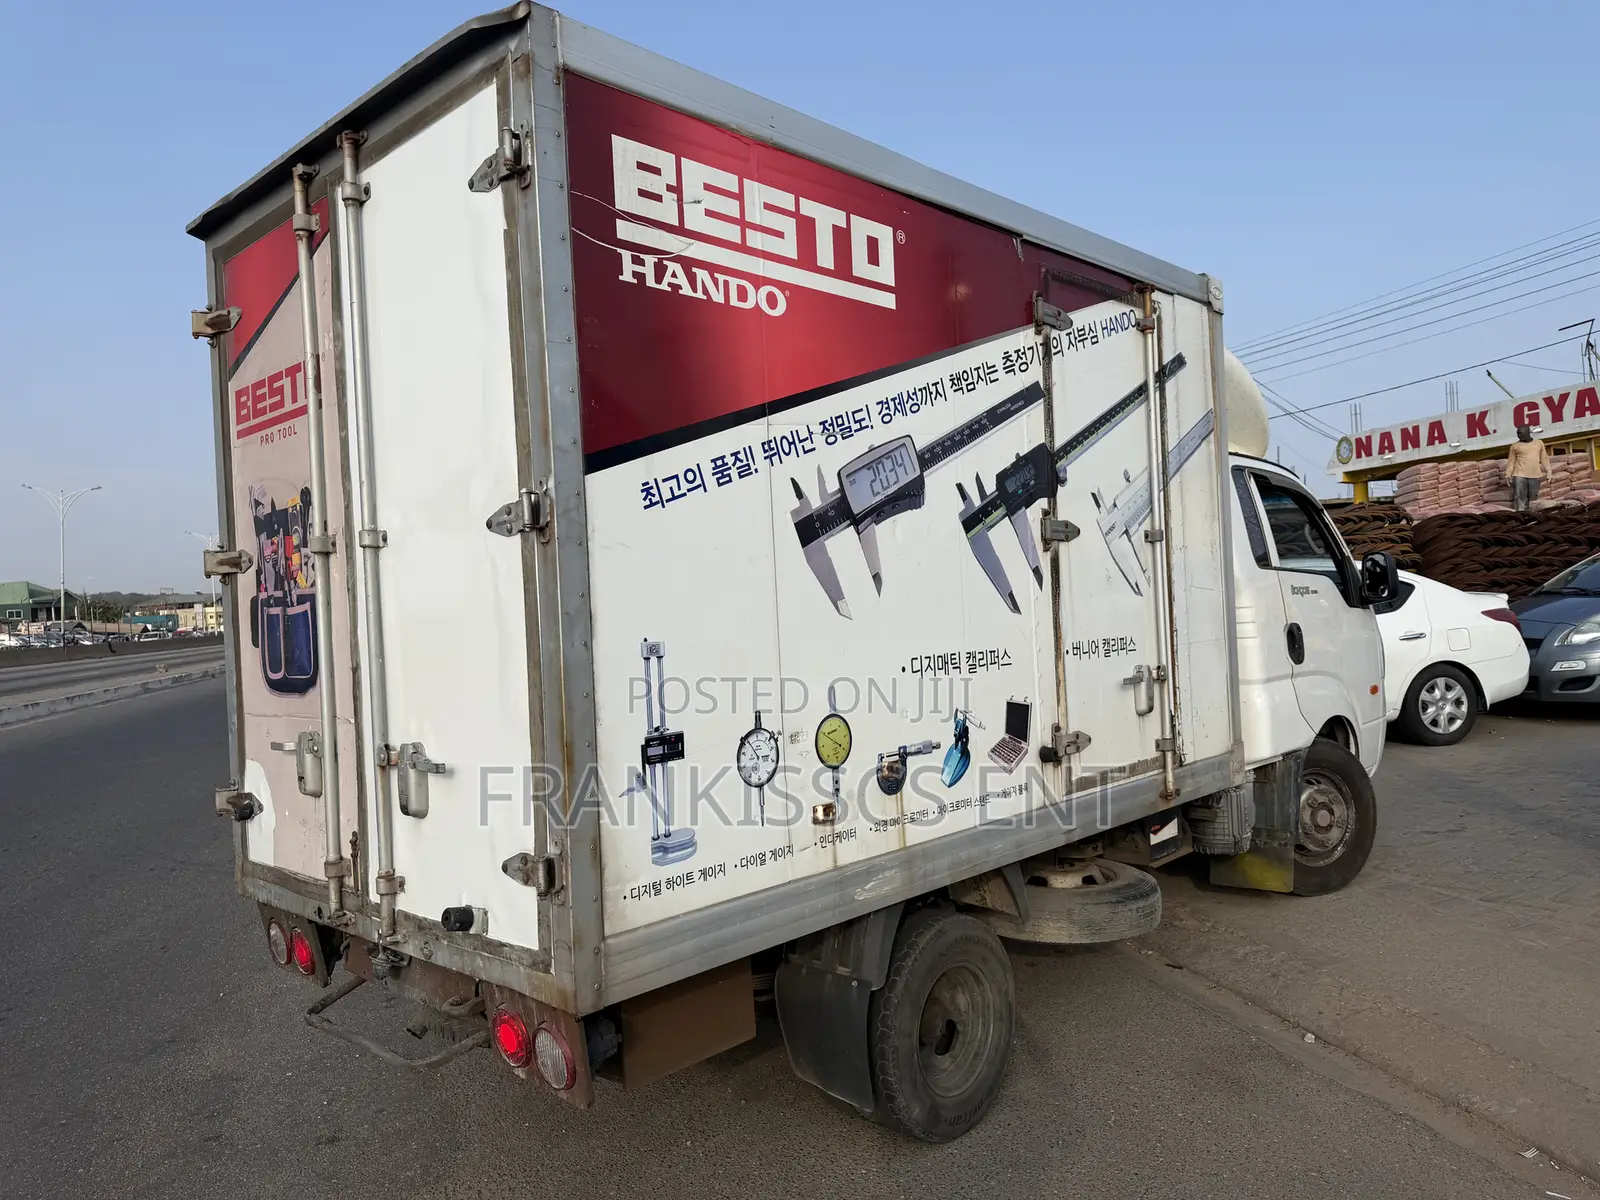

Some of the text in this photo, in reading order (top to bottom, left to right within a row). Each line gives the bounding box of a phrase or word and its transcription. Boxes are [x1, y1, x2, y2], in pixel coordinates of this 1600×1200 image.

[640, 463, 707, 510] 최고의
[710, 446, 759, 488] 품질!
[761, 425, 816, 467] 뛰어난
[818, 404, 874, 446] 정밀도!
[875, 377, 947, 424] 경제성까지
[949, 362, 999, 395] 책임지는
[1066, 322, 1100, 350] 자부심
[1100, 308, 1137, 339] HANDO
[260, 424, 297, 447] PRO TOOL
[1355, 419, 1447, 459] NANA
[1466, 410, 1497, 439] K.
[1071, 636, 1137, 661] 버니어 캘리퍼스
[911, 648, 1012, 679] 디지매틱 캘리퍼스
[874, 808, 929, 833] 외경 마이크로미터
[819, 827, 857, 849] 인디케이터
[740, 844, 794, 870] 다이얼 게이지
[630, 862, 726, 901] 디지털 하이트 게이지
